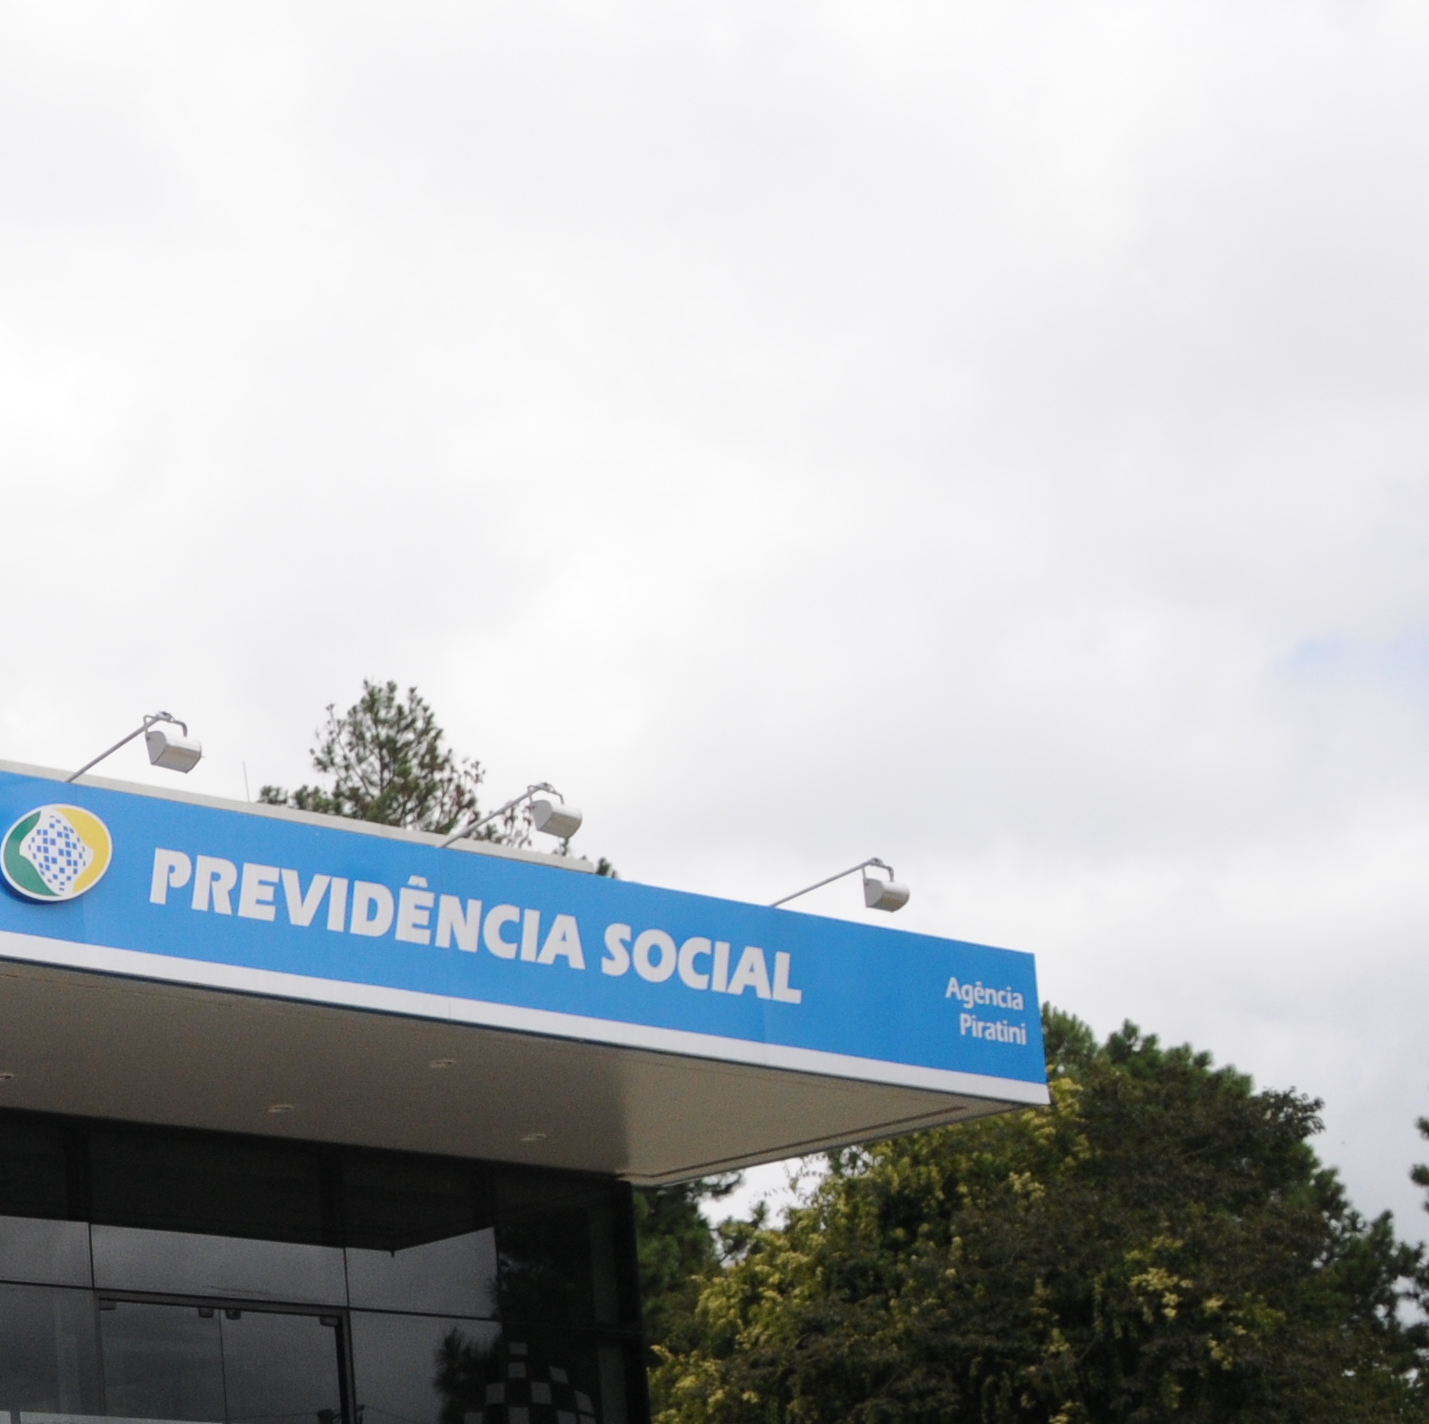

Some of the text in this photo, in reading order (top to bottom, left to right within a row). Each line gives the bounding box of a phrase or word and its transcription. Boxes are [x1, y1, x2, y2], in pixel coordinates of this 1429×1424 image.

[149, 847, 802, 1004] PREVIDÊNCIA SOCIAL
[945, 976, 1024, 1010] Agência
[959, 1012, 1027, 1045] Piratini
